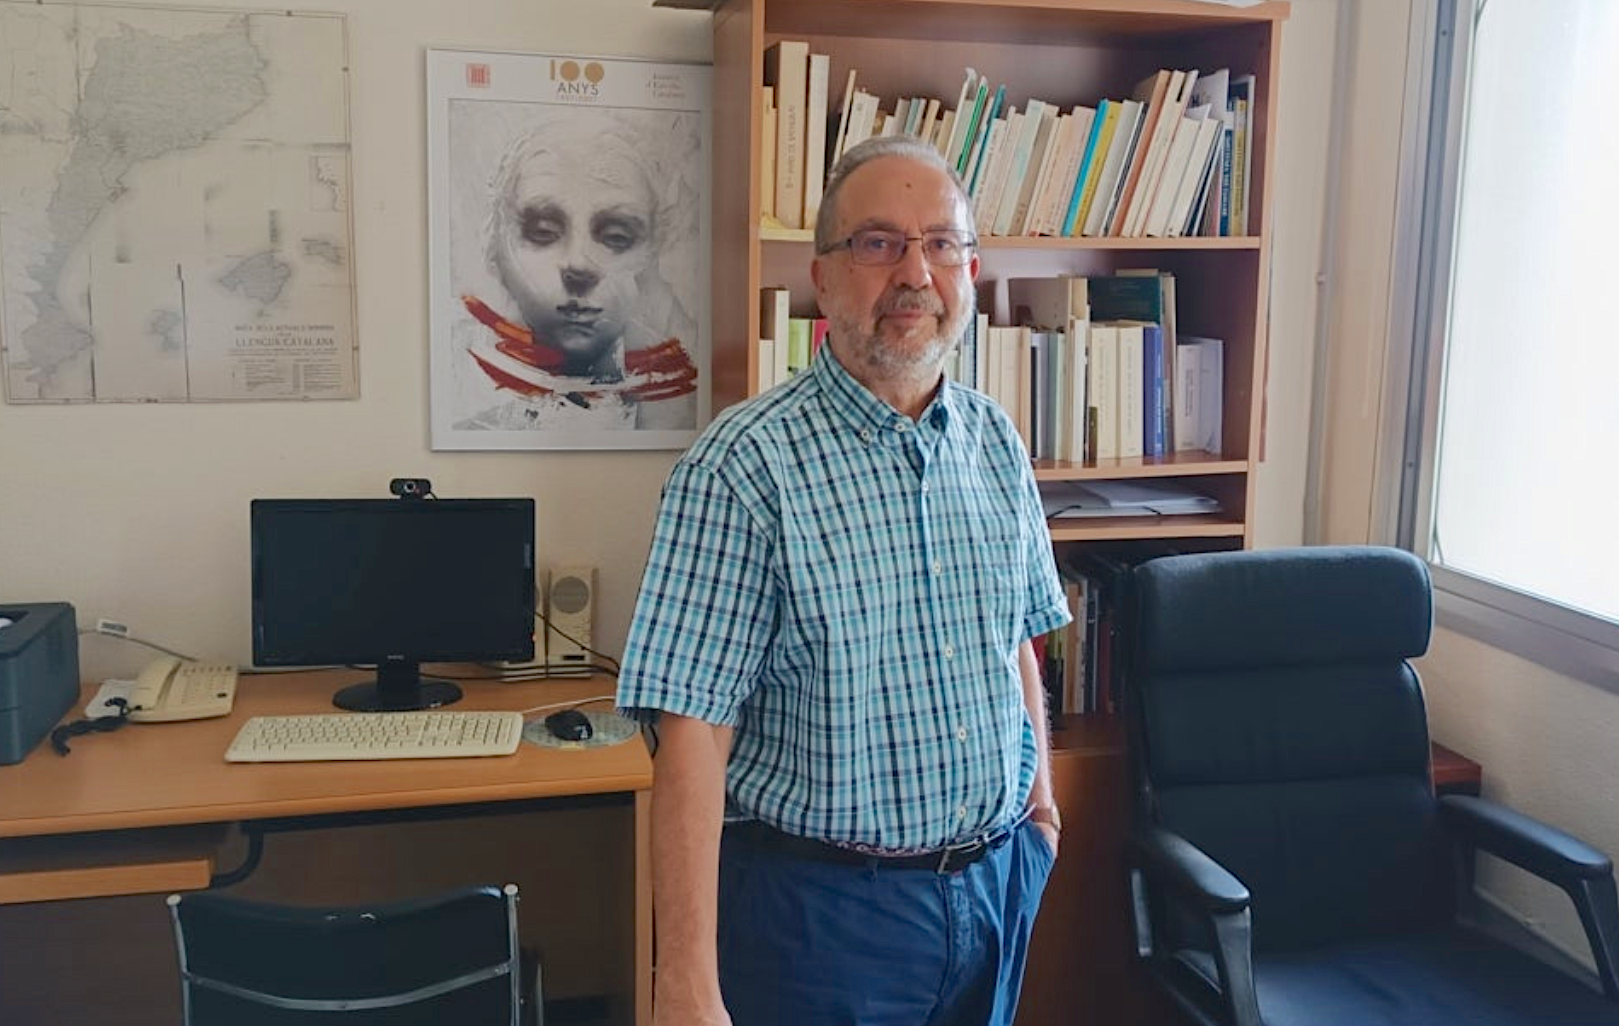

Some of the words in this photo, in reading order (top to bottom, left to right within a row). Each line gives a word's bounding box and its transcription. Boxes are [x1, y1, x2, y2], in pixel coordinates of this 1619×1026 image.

[550, 59, 605, 83] 100
[557, 83, 599, 95] ANYS
[282, 337, 334, 347] CATALANA
